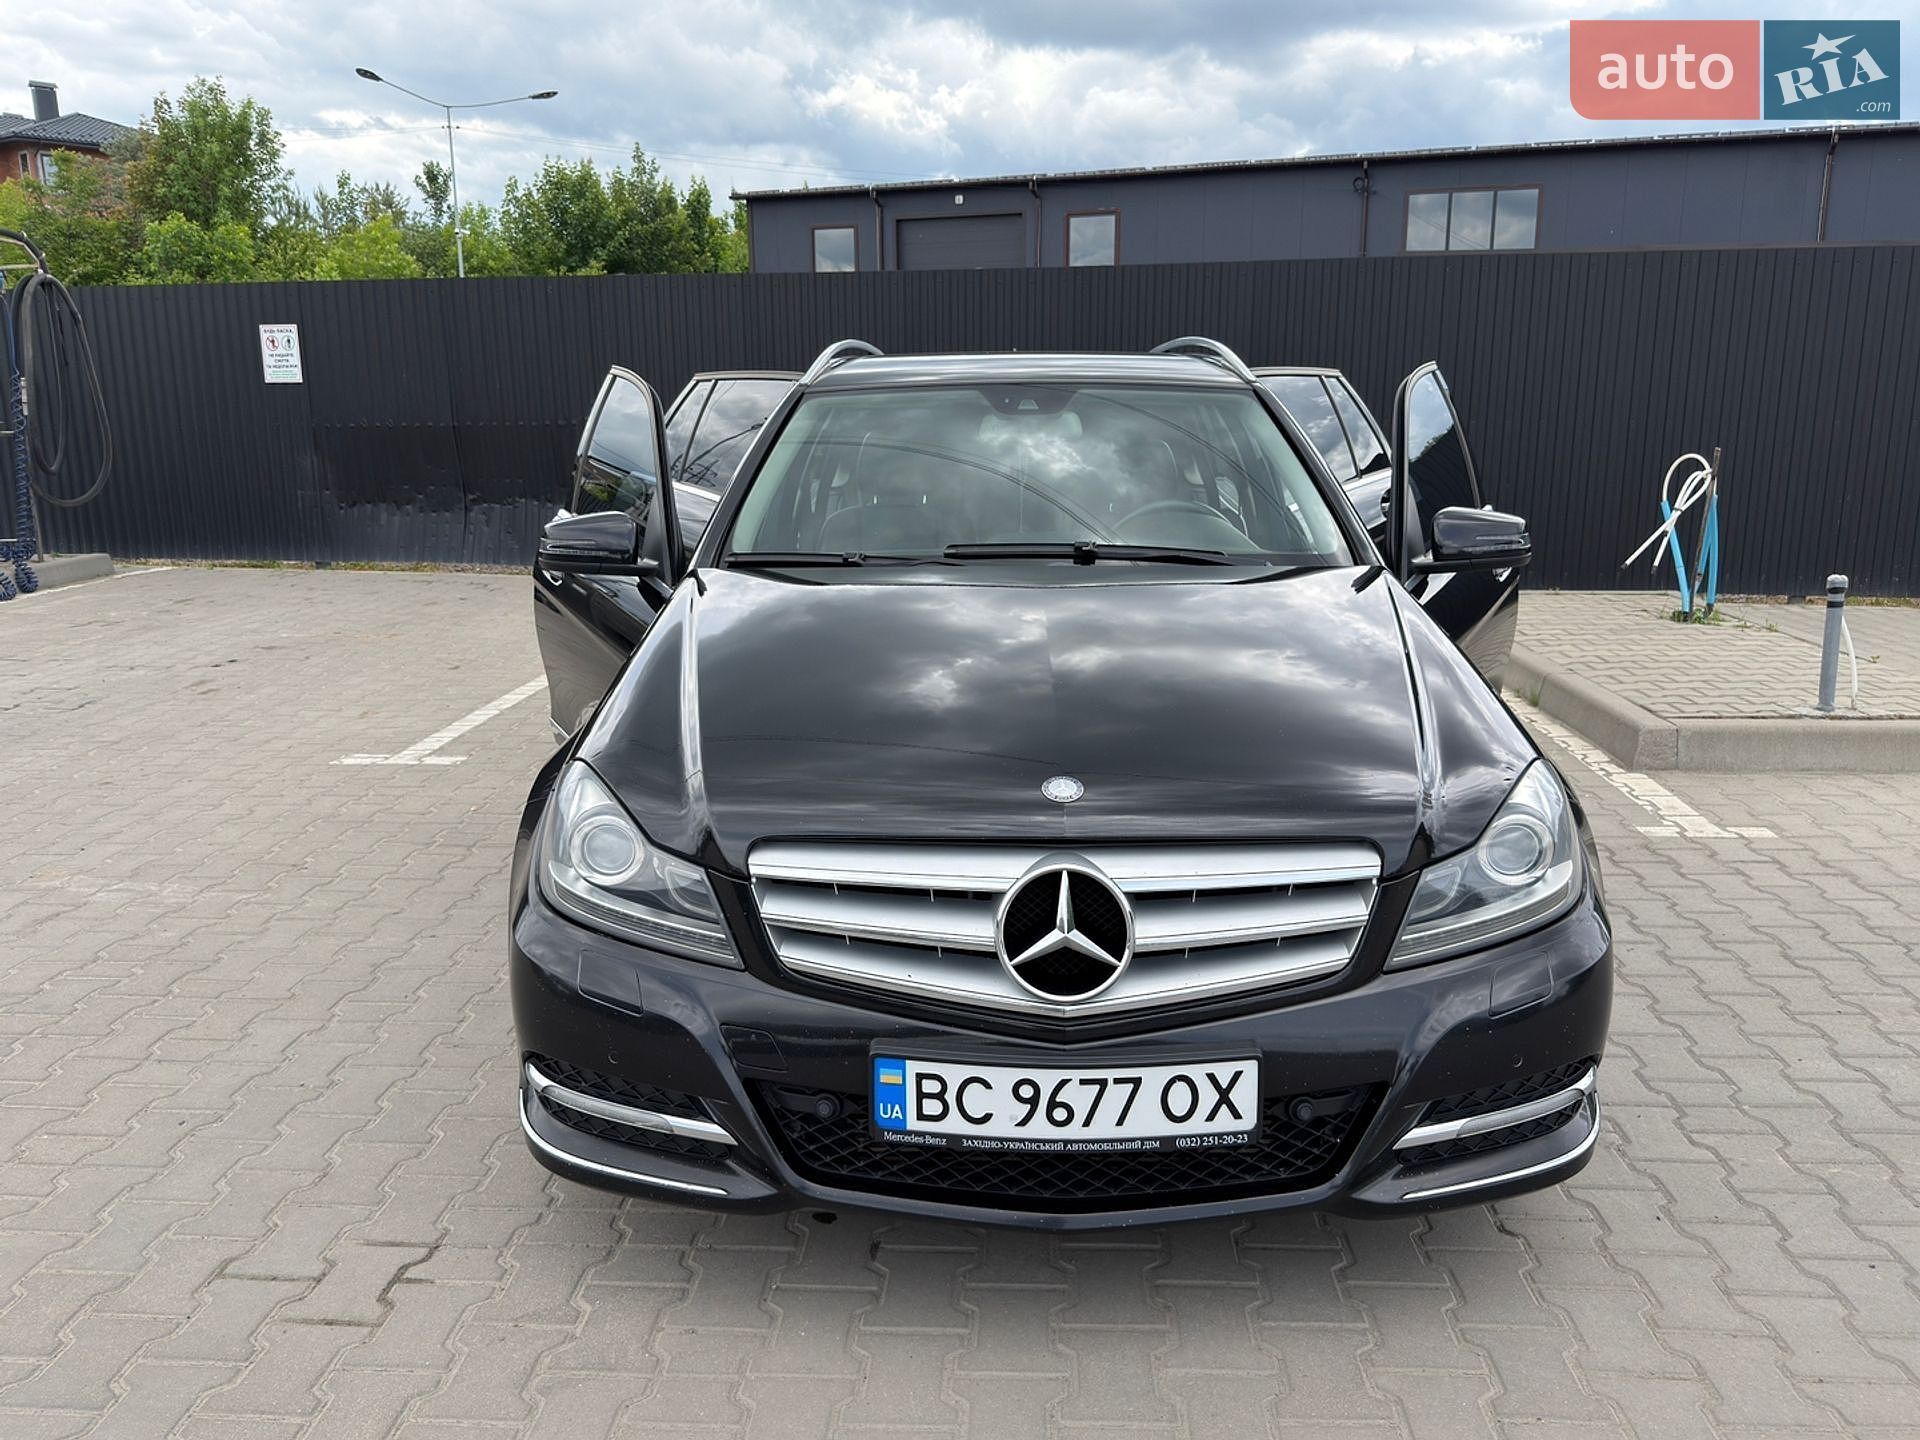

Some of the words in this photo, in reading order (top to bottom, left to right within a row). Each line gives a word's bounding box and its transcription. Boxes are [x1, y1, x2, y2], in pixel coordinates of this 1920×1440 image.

[914, 1071, 994, 1126] BC
[1009, 1077, 1143, 1128] 9677
[1159, 1069, 1245, 1123] OX
[879, 1102, 903, 1120] UA
[883, 1131, 947, 1146] Mercedes-Benz
[961, 1138, 1064, 1151] ЗАХІДНО-УКРАЇНСЬКИЙ
[1066, 1141, 1140, 1151] АВТОМОБІЛЬНИЙ
[1142, 1140, 1161, 1150] ДІМ
[1175, 1137, 1201, 1148] (032)
[1202, 1134, 1249, 1146] 251-20-23
